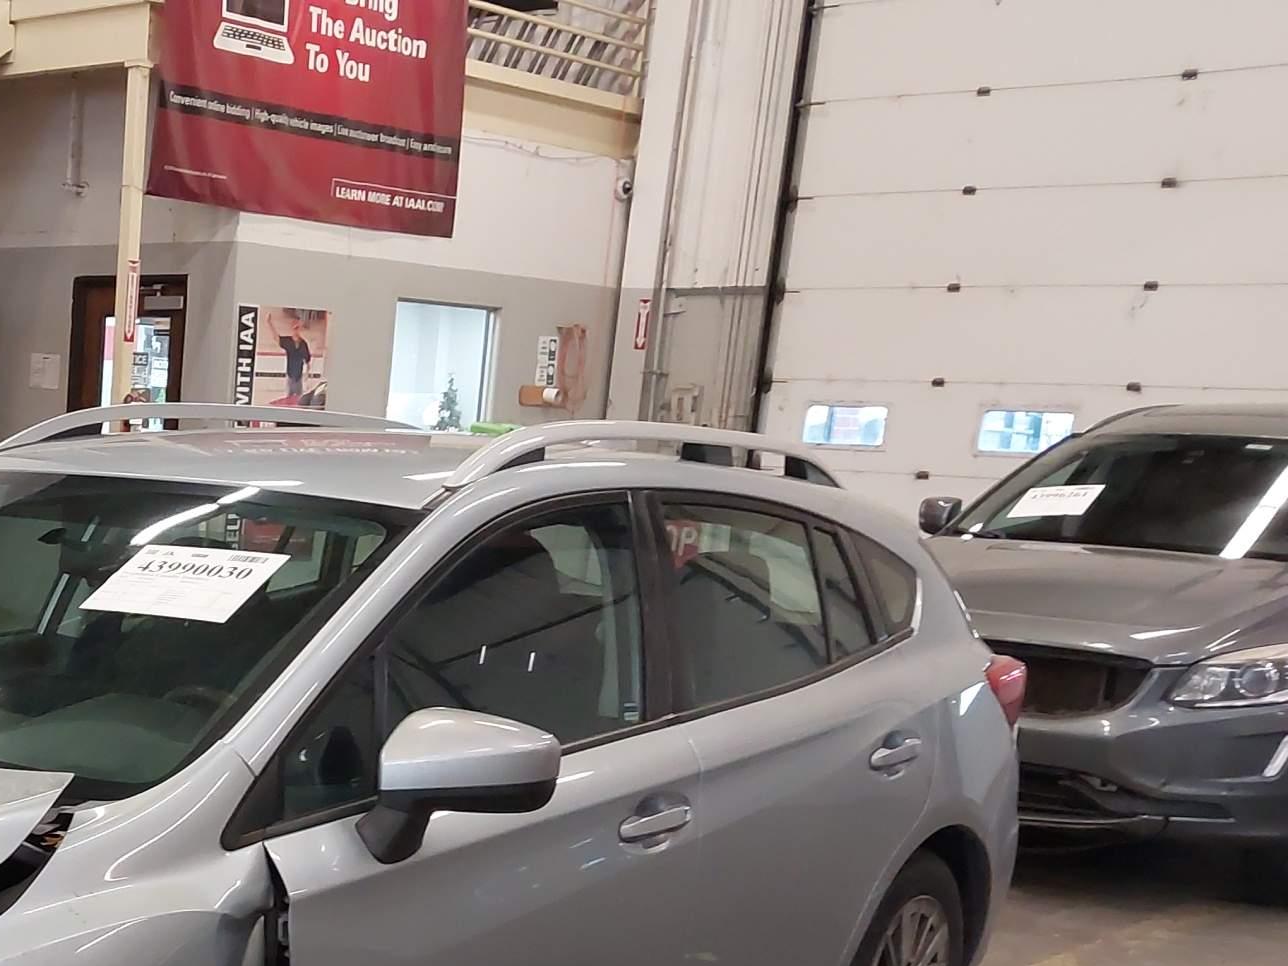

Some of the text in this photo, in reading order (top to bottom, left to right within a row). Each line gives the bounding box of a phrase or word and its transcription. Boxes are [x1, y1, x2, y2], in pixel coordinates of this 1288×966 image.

[309, 5, 345, 39] The
[349, 17, 427, 59] Auction
[305, 43, 371, 82] To You
[335, 186, 366, 203] LEARN
[367, 191, 392, 206] MORE
[391, 196, 404, 208] AT
[238, 311, 256, 351] IAA
[136, 559, 254, 580] 43990030
